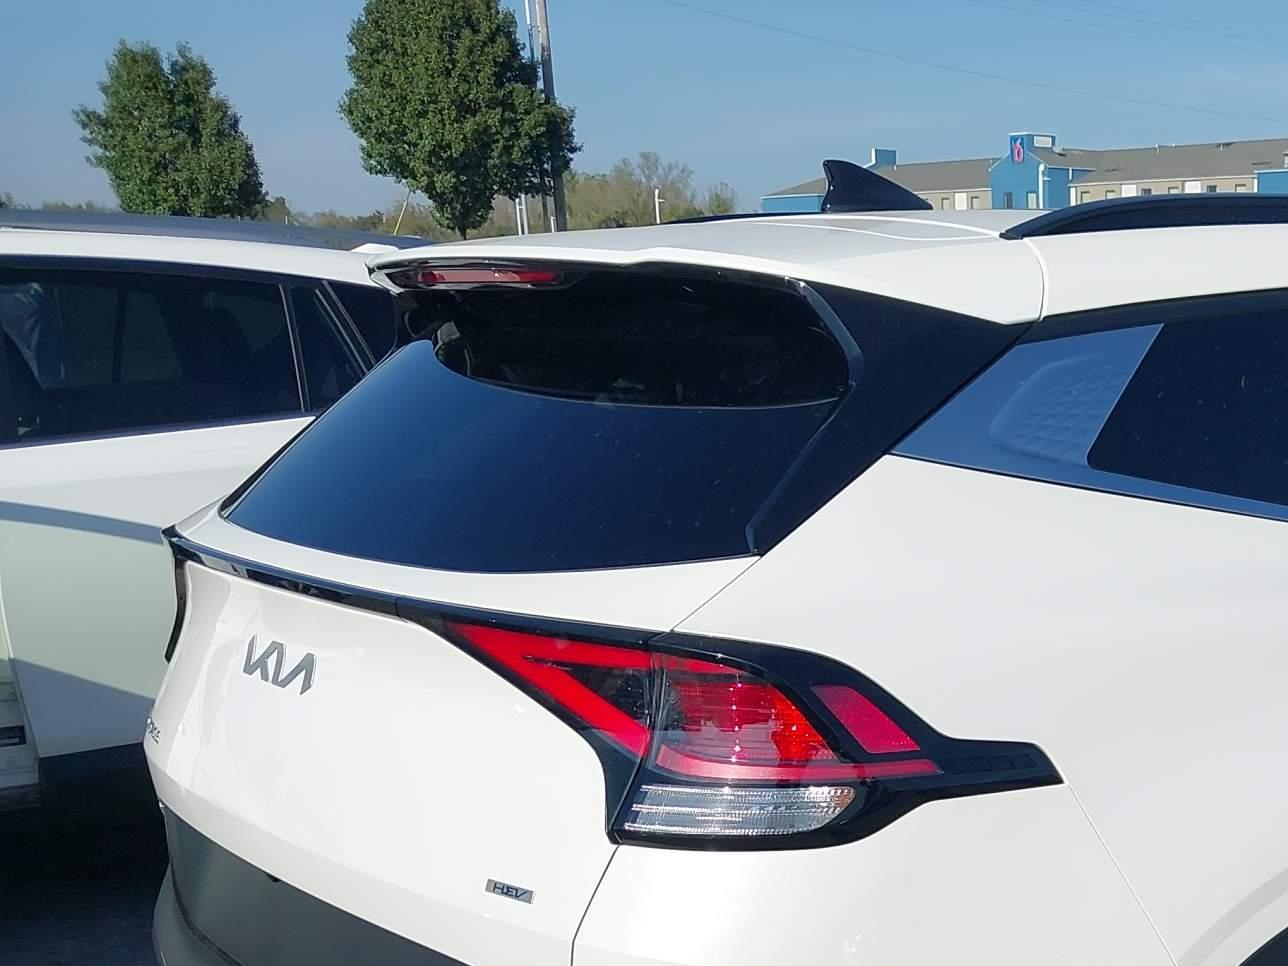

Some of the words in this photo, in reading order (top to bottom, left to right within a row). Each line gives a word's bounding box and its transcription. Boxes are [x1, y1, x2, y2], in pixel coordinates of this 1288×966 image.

[1013, 138, 1024, 163] 6
[242, 634, 317, 696] KIA
[490, 881, 529, 900] HEV
